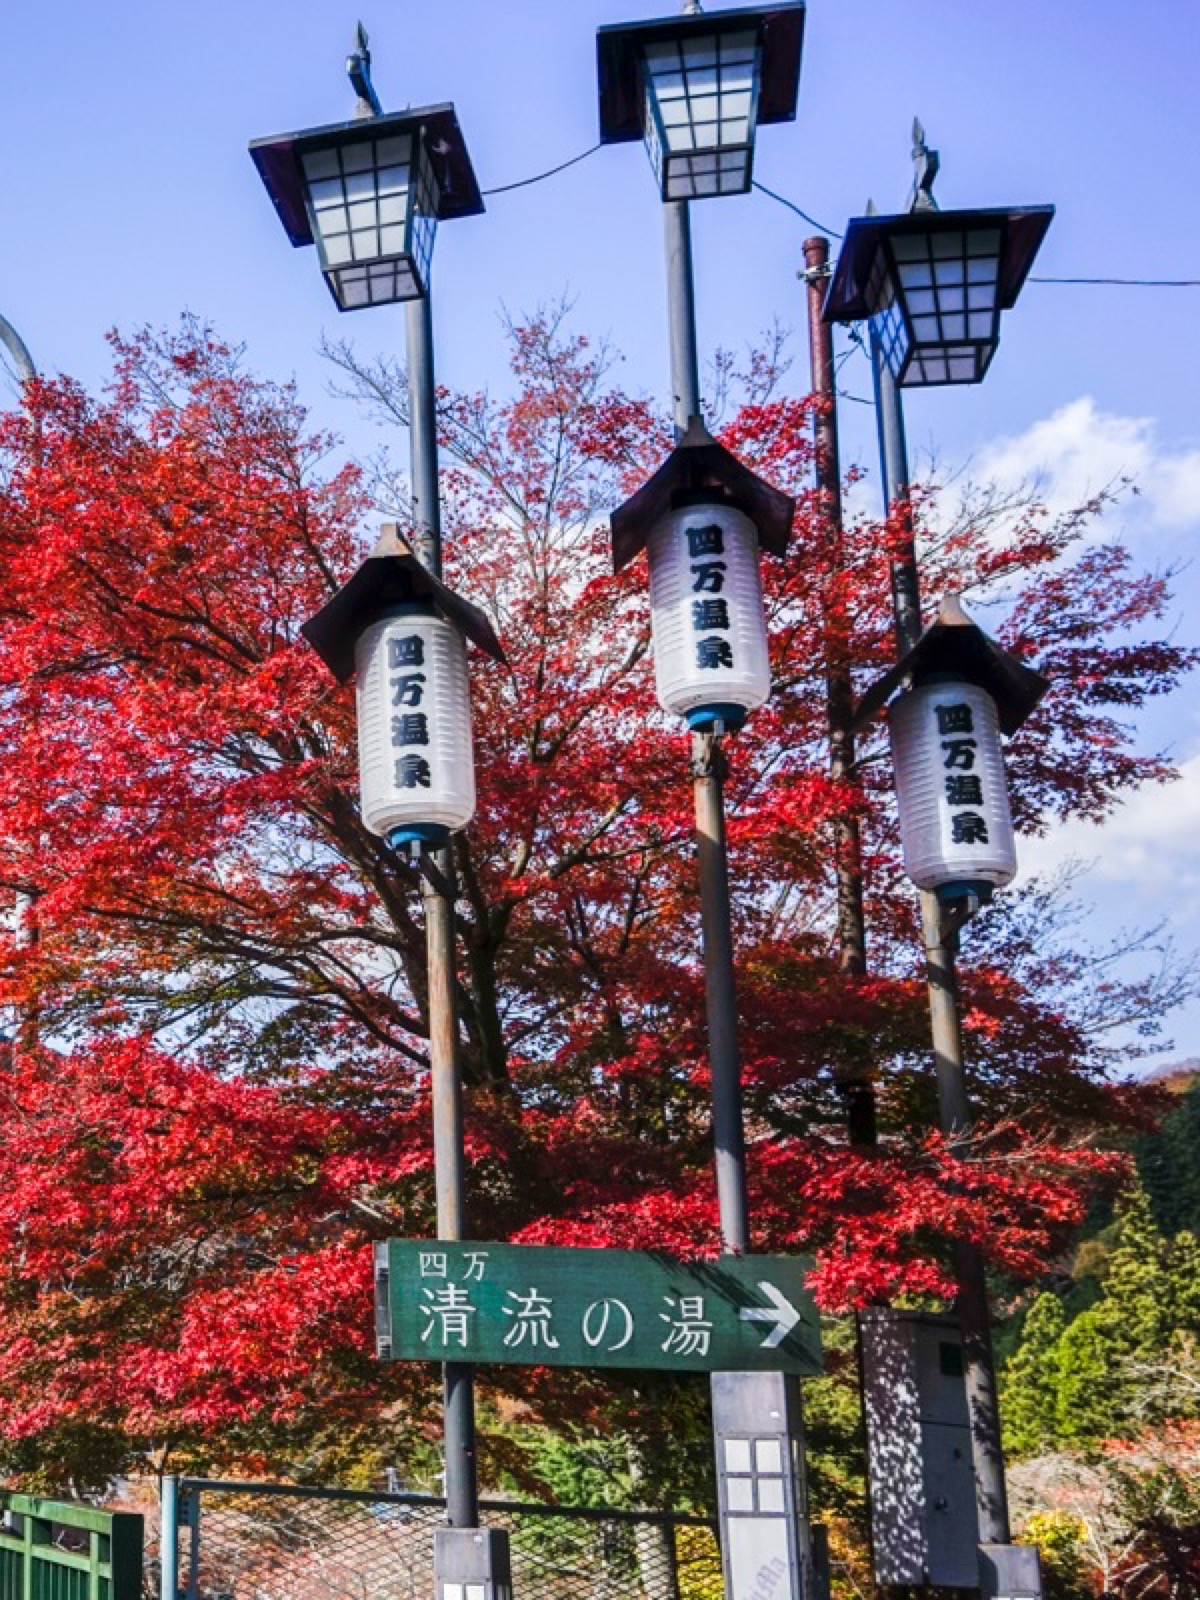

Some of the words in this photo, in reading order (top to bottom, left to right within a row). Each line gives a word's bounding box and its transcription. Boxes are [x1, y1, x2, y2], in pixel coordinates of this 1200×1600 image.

[686, 523, 733, 669] 四万温泉
[386, 634, 431, 788] 四万温泉
[934, 703, 988, 844] 四万温泉
[418, 1251, 489, 1282] 四万
[418, 1283, 713, 1357] 清流の湯
